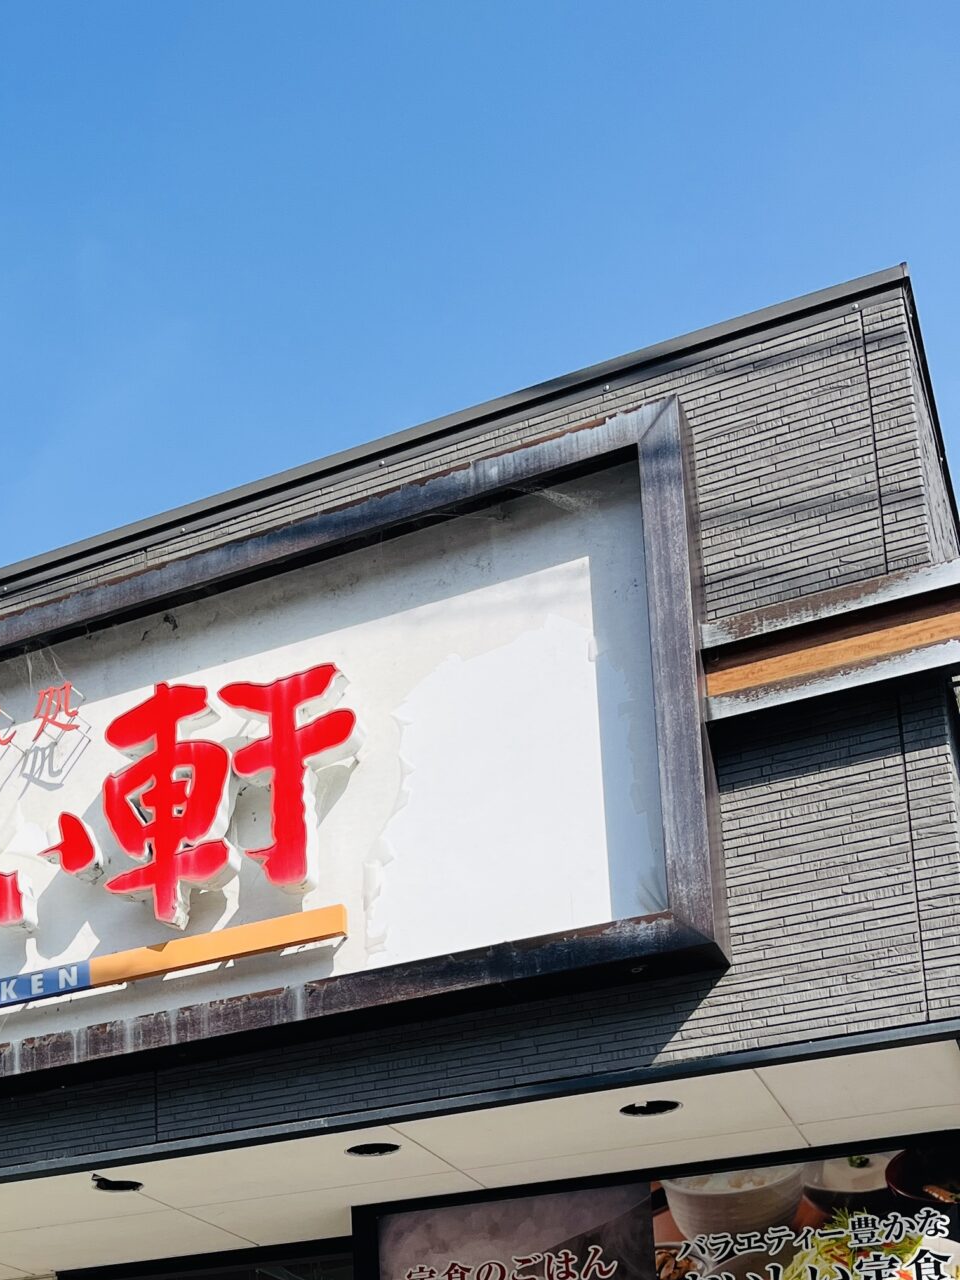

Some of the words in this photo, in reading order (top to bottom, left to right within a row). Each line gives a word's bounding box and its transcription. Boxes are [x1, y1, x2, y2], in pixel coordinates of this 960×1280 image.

[676, 1208, 950, 1260] バラエティー豊かな
